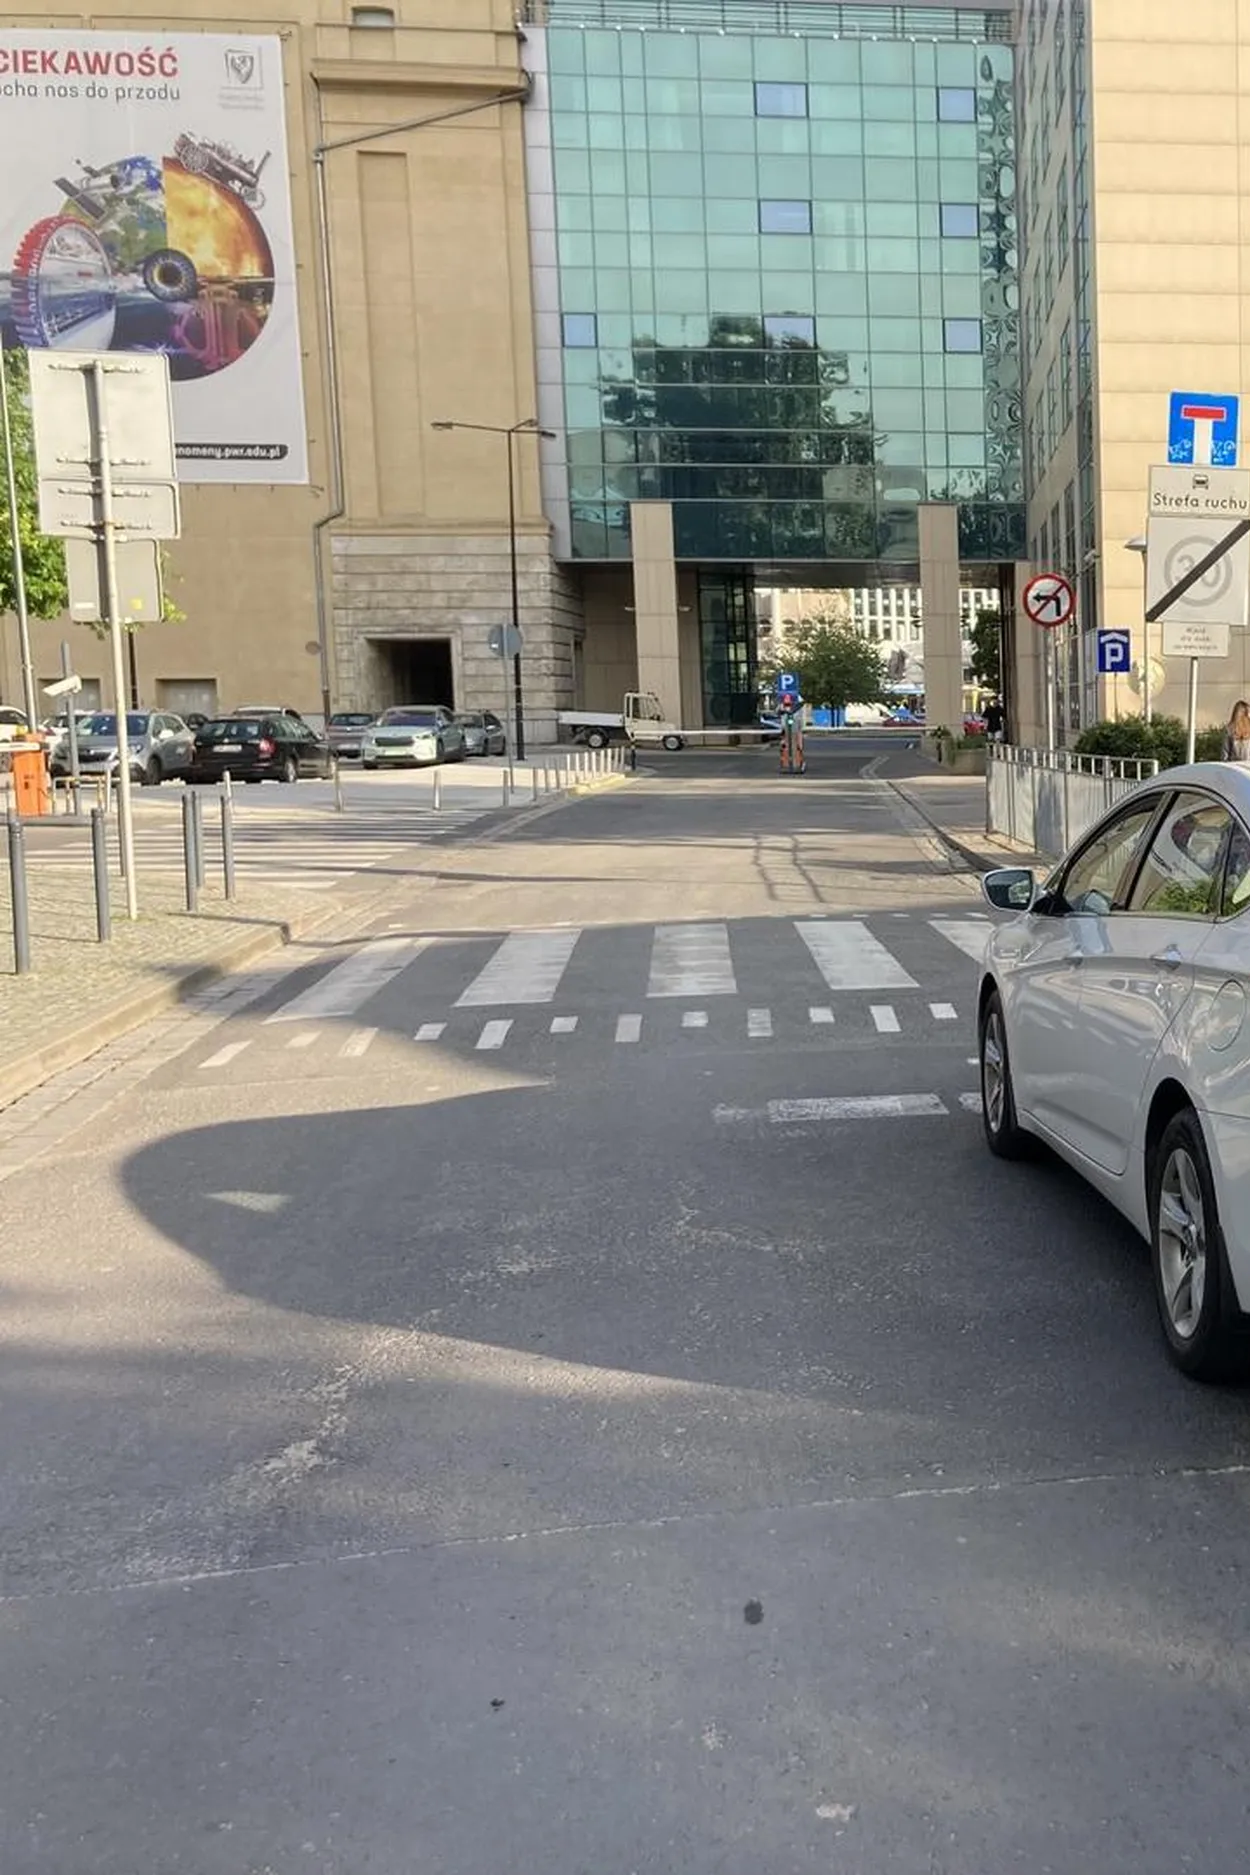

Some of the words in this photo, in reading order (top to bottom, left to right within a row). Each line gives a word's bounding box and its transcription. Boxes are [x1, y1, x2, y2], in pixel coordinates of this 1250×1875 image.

[0, 79, 38, 97] cha
[45, 84, 79, 98] nas
[86, 80, 109, 98] do
[115, 82, 180, 103] przodu
[176, 446, 280, 459] nomeny.pwr.edu.pl
[1153, 492, 1199, 508] Strefa
[1205, 496, 1248, 509] ruchu
[1105, 643, 1123, 670] P
[781, 674, 794, 690] P
